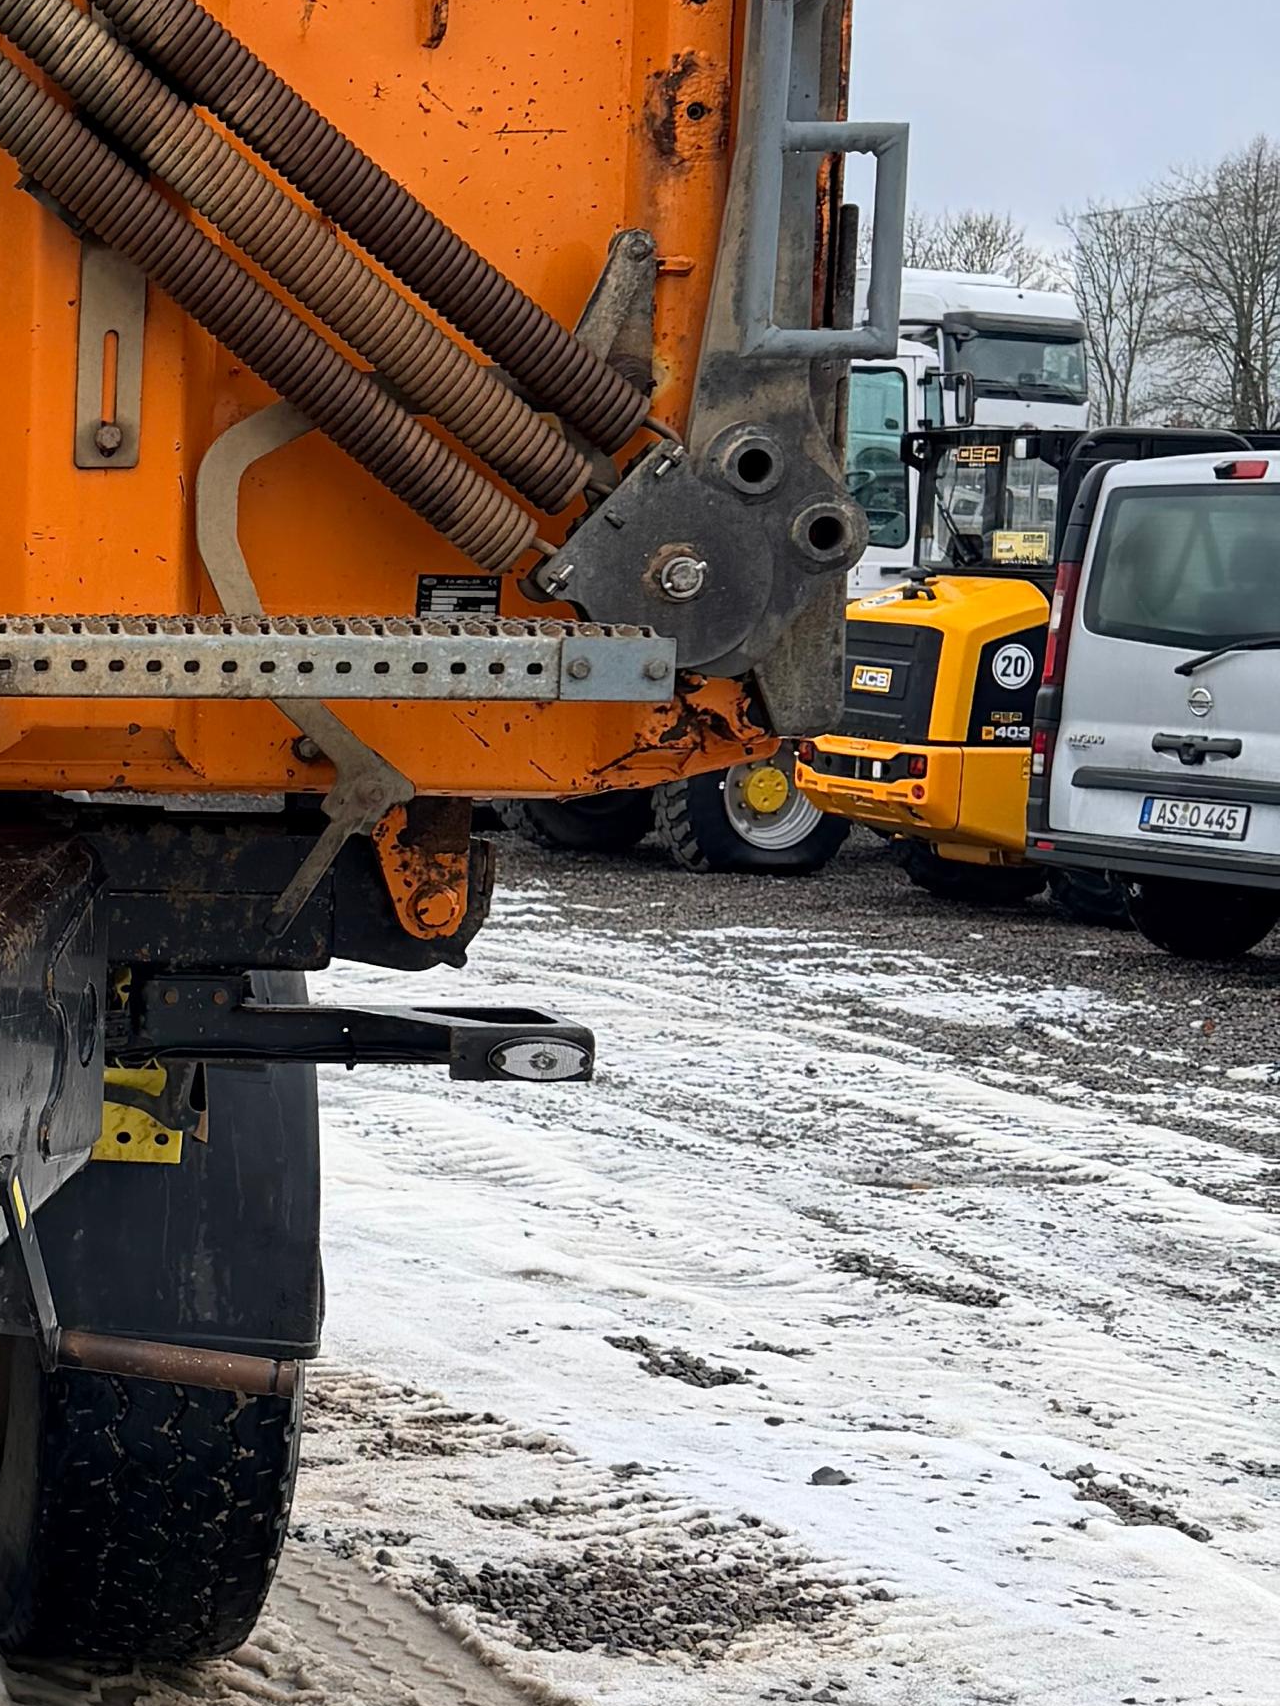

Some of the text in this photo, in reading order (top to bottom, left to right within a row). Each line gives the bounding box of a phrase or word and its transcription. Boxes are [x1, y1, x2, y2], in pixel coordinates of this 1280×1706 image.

[1000, 655, 1025, 677] 20
[855, 669, 888, 687] JCB
[995, 726, 1031, 739] 403
[1156, 803, 1179, 825] AS
[1203, 807, 1239, 831] 445
